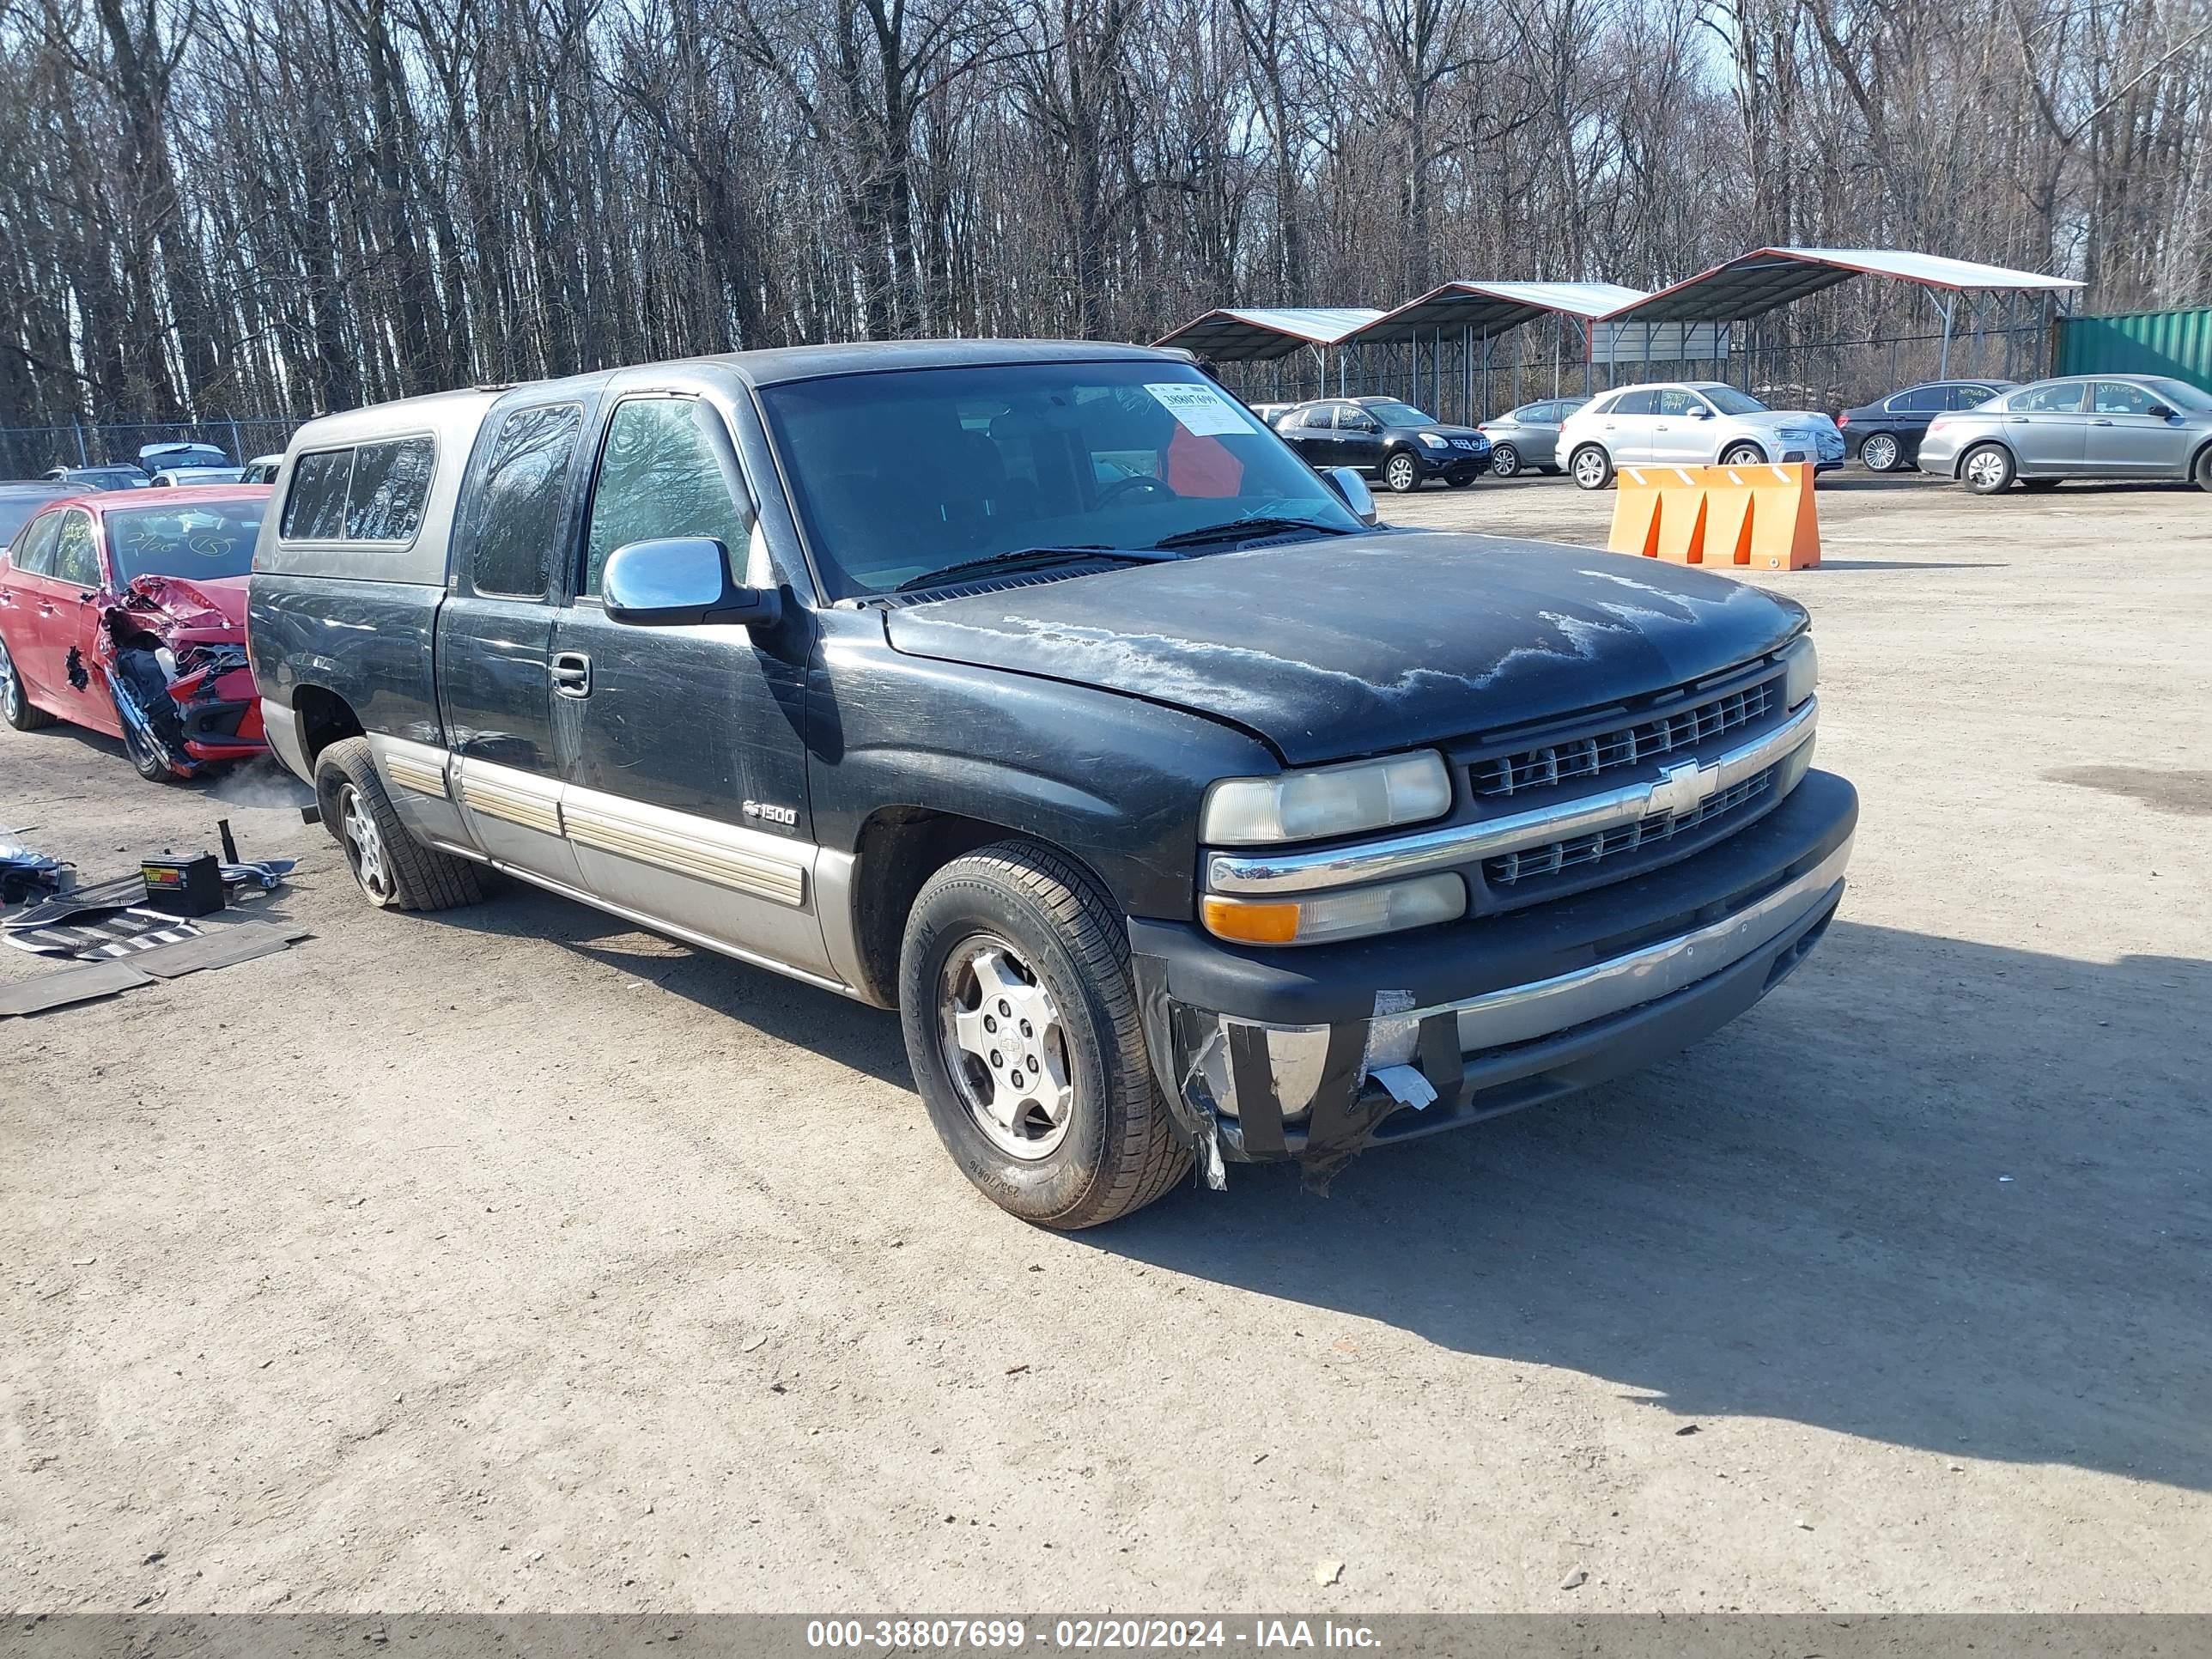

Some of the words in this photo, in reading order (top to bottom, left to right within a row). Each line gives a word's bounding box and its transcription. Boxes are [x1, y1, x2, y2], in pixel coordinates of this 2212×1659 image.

[1164, 394, 1218, 405] 38807699
[761, 804, 797, 825] 1500
[969, 1160, 1021, 1198] 255/70R16
